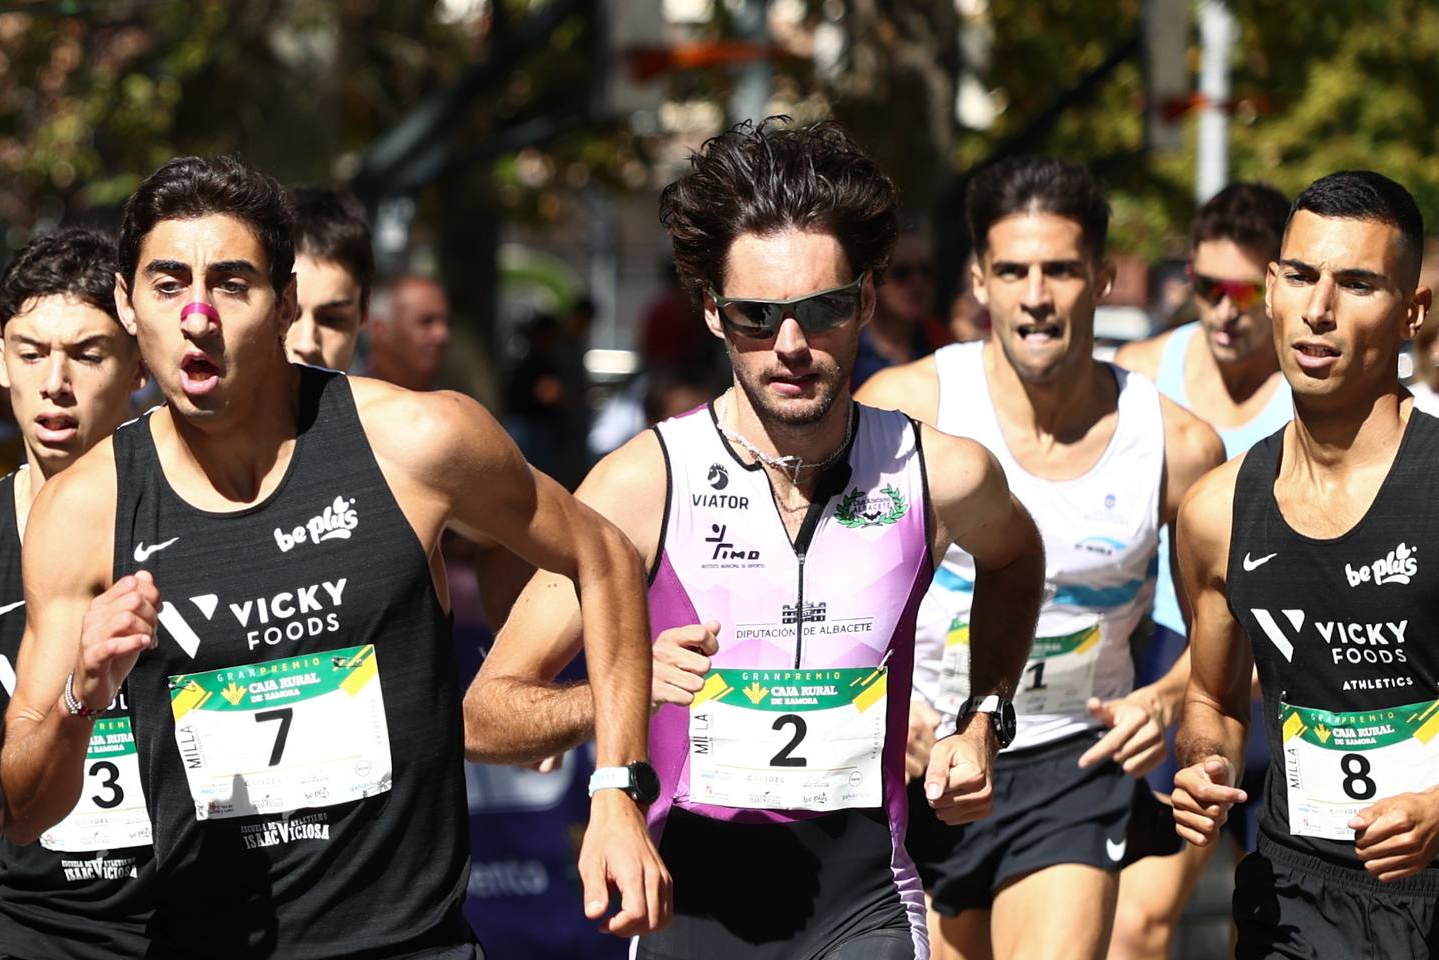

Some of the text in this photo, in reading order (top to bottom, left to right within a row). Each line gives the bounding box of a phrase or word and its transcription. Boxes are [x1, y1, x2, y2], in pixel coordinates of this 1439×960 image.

[692, 494, 749, 510] VIATOR
[273, 496, 359, 552] be plus
[1344, 543, 1418, 588] be plus
[229, 578, 347, 628] VICKY
[247, 613, 340, 650] FOODS
[736, 623, 872, 639] DIPUTACIÓN DE ALBACETE
[1314, 620, 1408, 646] VICKY
[1331, 647, 1407, 665] FOODS
[249, 672, 321, 693] CAJA RURAL
[250, 688, 301, 703] DE ZAMORA
[771, 685, 838, 696] CAJA RURAL
[1342, 677, 1413, 691] ATHLETICS
[180, 725, 202, 769] MILLA
[254, 707, 293, 767] 7
[694, 713, 709, 754] MILLA
[769, 714, 807, 767] 2
[1333, 724, 1395, 738] CAJA RURAL
[1345, 737, 1377, 745] ZAMORA
[89, 761, 124, 809] 3
[1287, 748, 1300, 789] MILLA
[1340, 753, 1377, 800] 8
